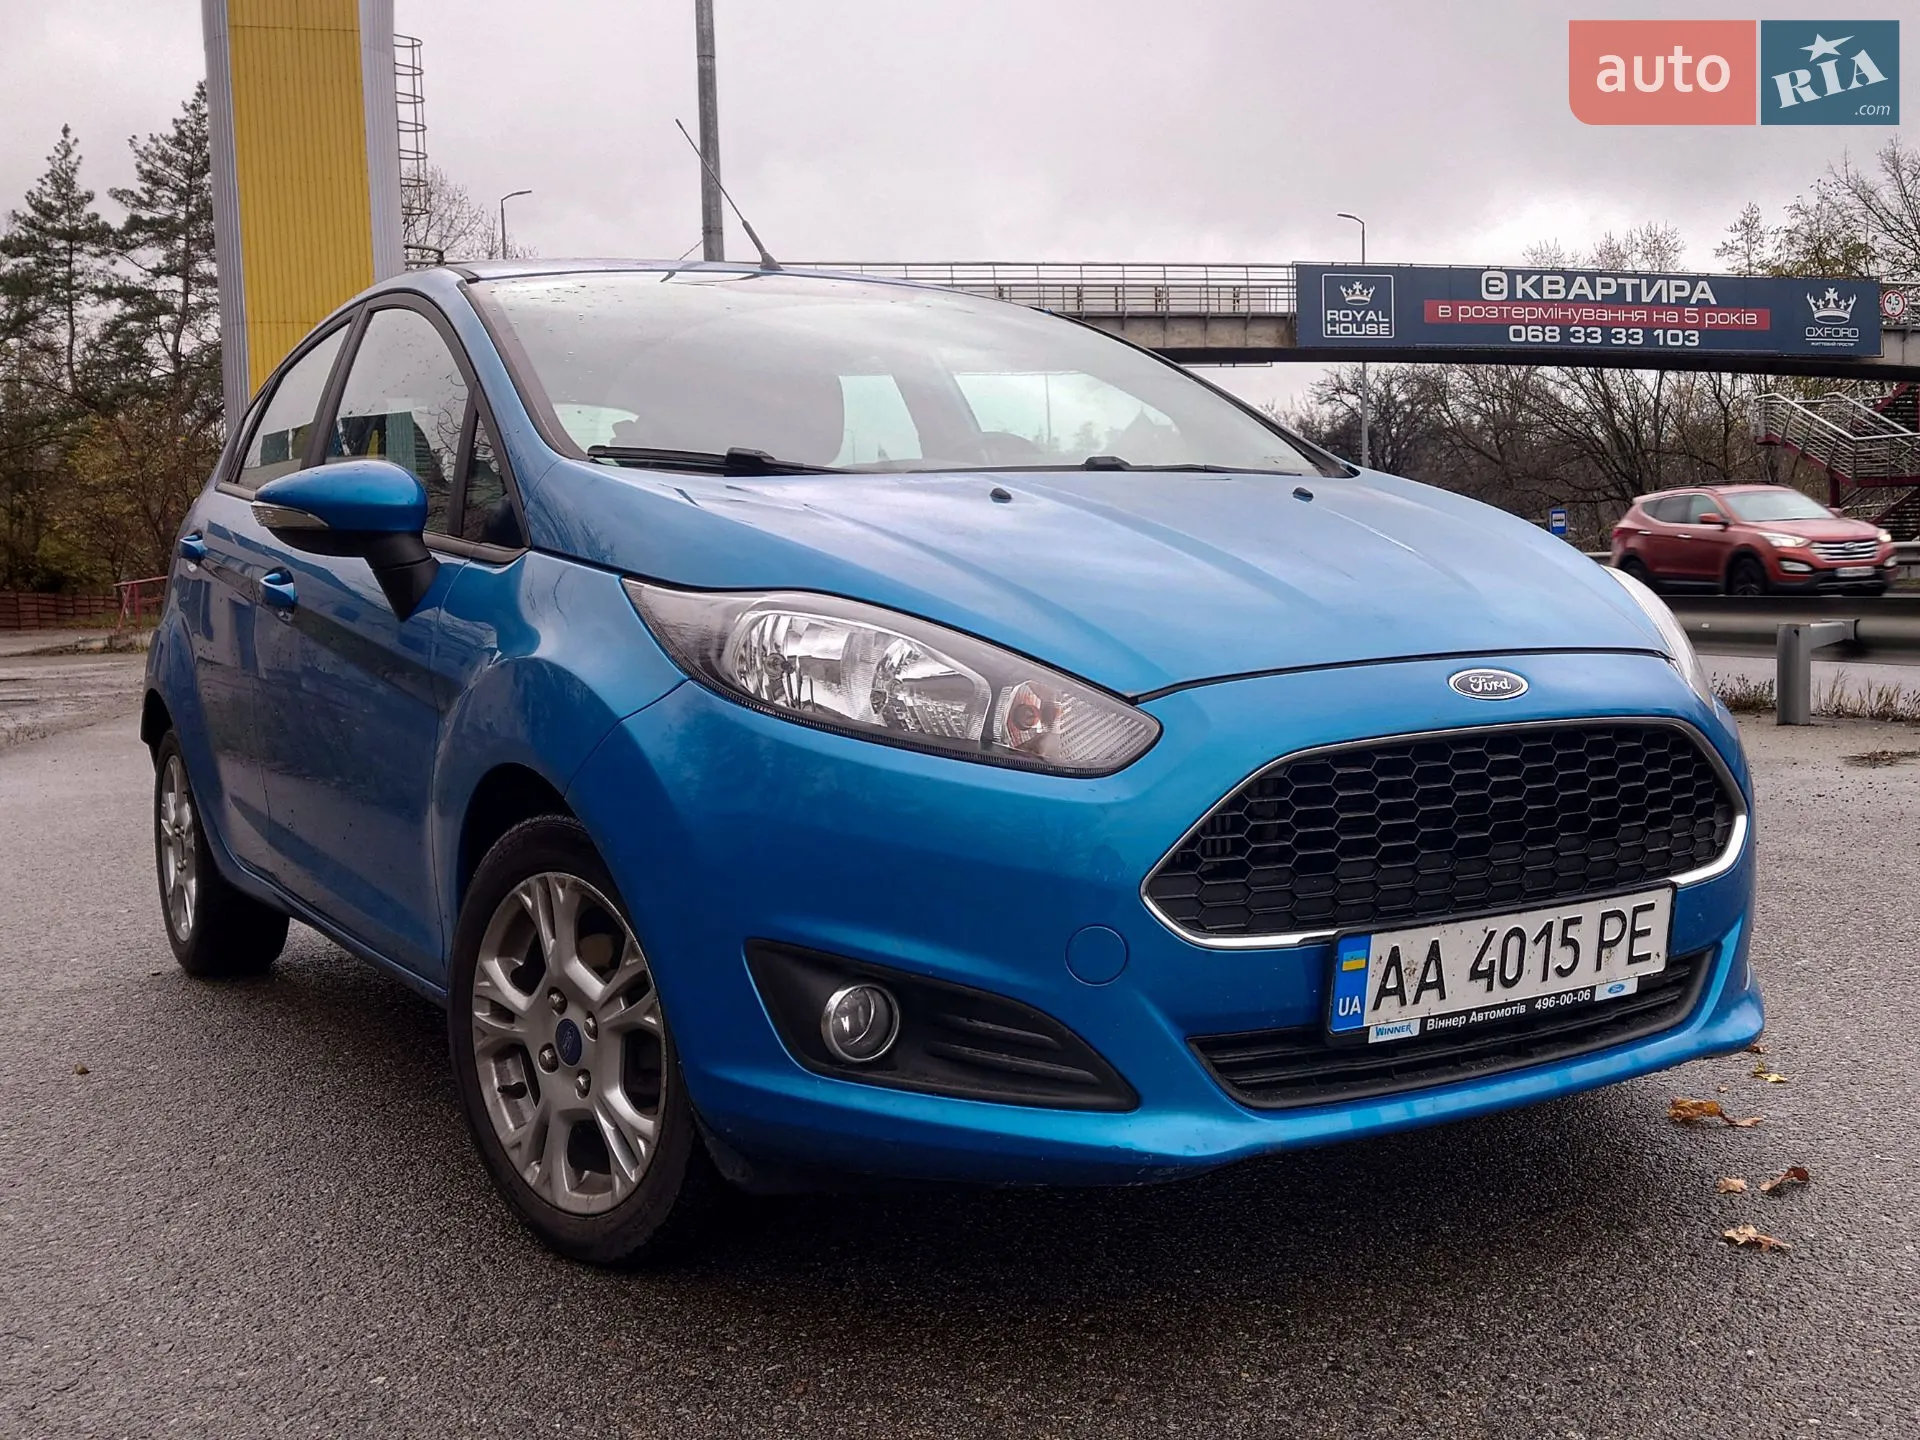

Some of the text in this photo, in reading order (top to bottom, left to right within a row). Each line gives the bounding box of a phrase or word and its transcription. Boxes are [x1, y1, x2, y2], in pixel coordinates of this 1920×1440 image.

[1515, 274, 1717, 304] КВАРТИРА
[1326, 309, 1389, 322] ROYAL
[1438, 304, 1758, 328] в розтермінування на 5 років
[1326, 323, 1390, 335] HOUSE
[1508, 325, 1700, 347] 068 33 33 103
[1805, 326, 1859, 338] OXFORD
[1469, 674, 1511, 693] Ford
[1469, 916, 1582, 993] 4015
[1338, 994, 1362, 1016] UA
[1426, 988, 1591, 1031] Віннер Автомотів 496-00-06
